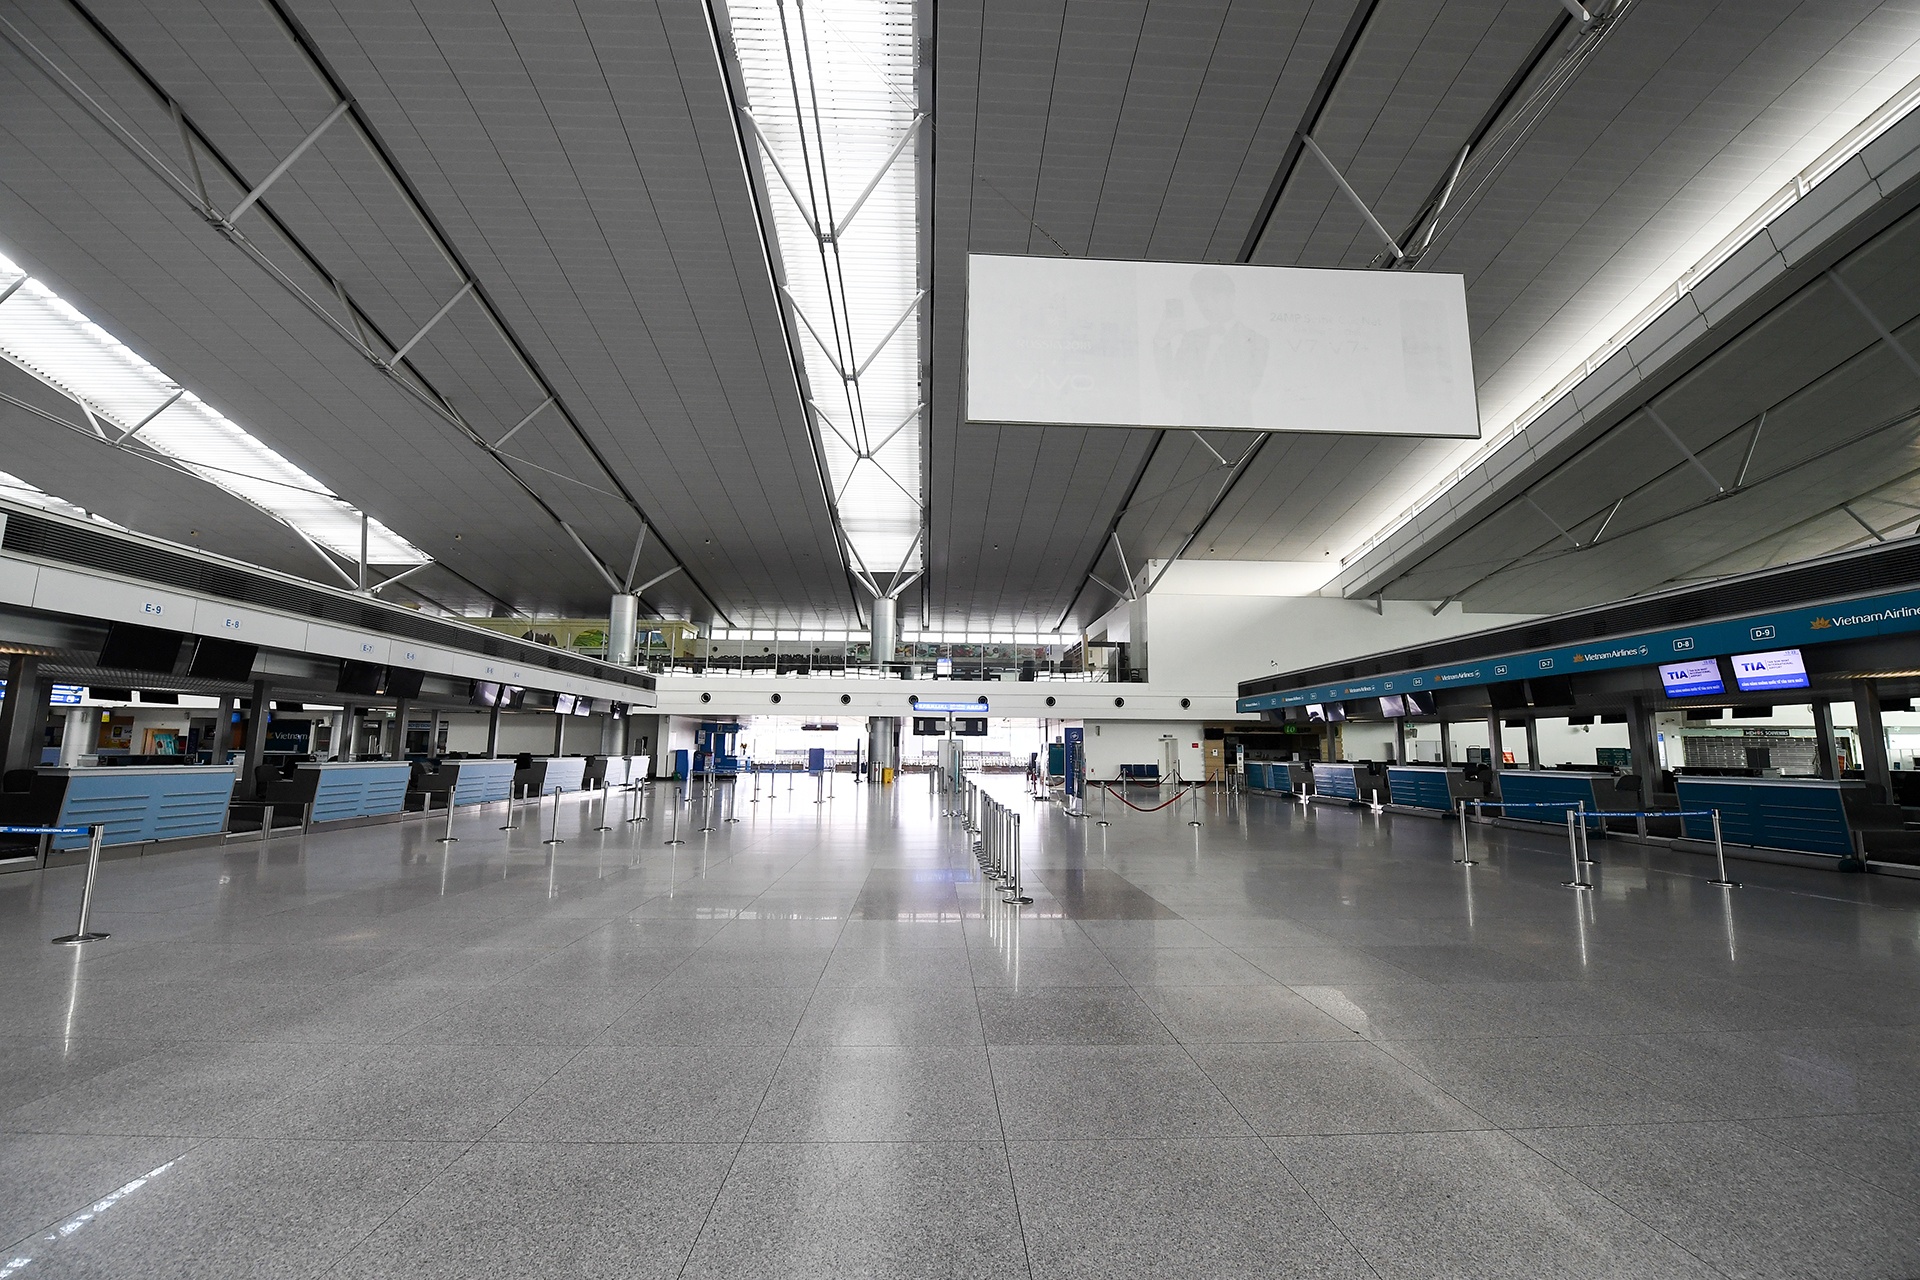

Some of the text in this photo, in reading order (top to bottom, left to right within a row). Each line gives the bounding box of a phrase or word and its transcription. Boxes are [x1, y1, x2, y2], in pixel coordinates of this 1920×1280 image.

[145, 603, 162, 614] E-9
[226, 619, 240, 629] E-8
[1832, 613, 1882, 627] Vietnam
[1755, 629, 1770, 638] D-9
[363, 644, 372, 652] E-7
[1677, 640, 1690, 649] D-8
[1584, 647, 1638, 661] Vietnam Airlines
[1541, 660, 1551, 668] D-7
[1741, 662, 1766, 672] TIA
[1459, 671, 1474, 679] Airlines
[1667, 671, 1688, 680] TIA
[275, 731, 308, 740] Vietnam
